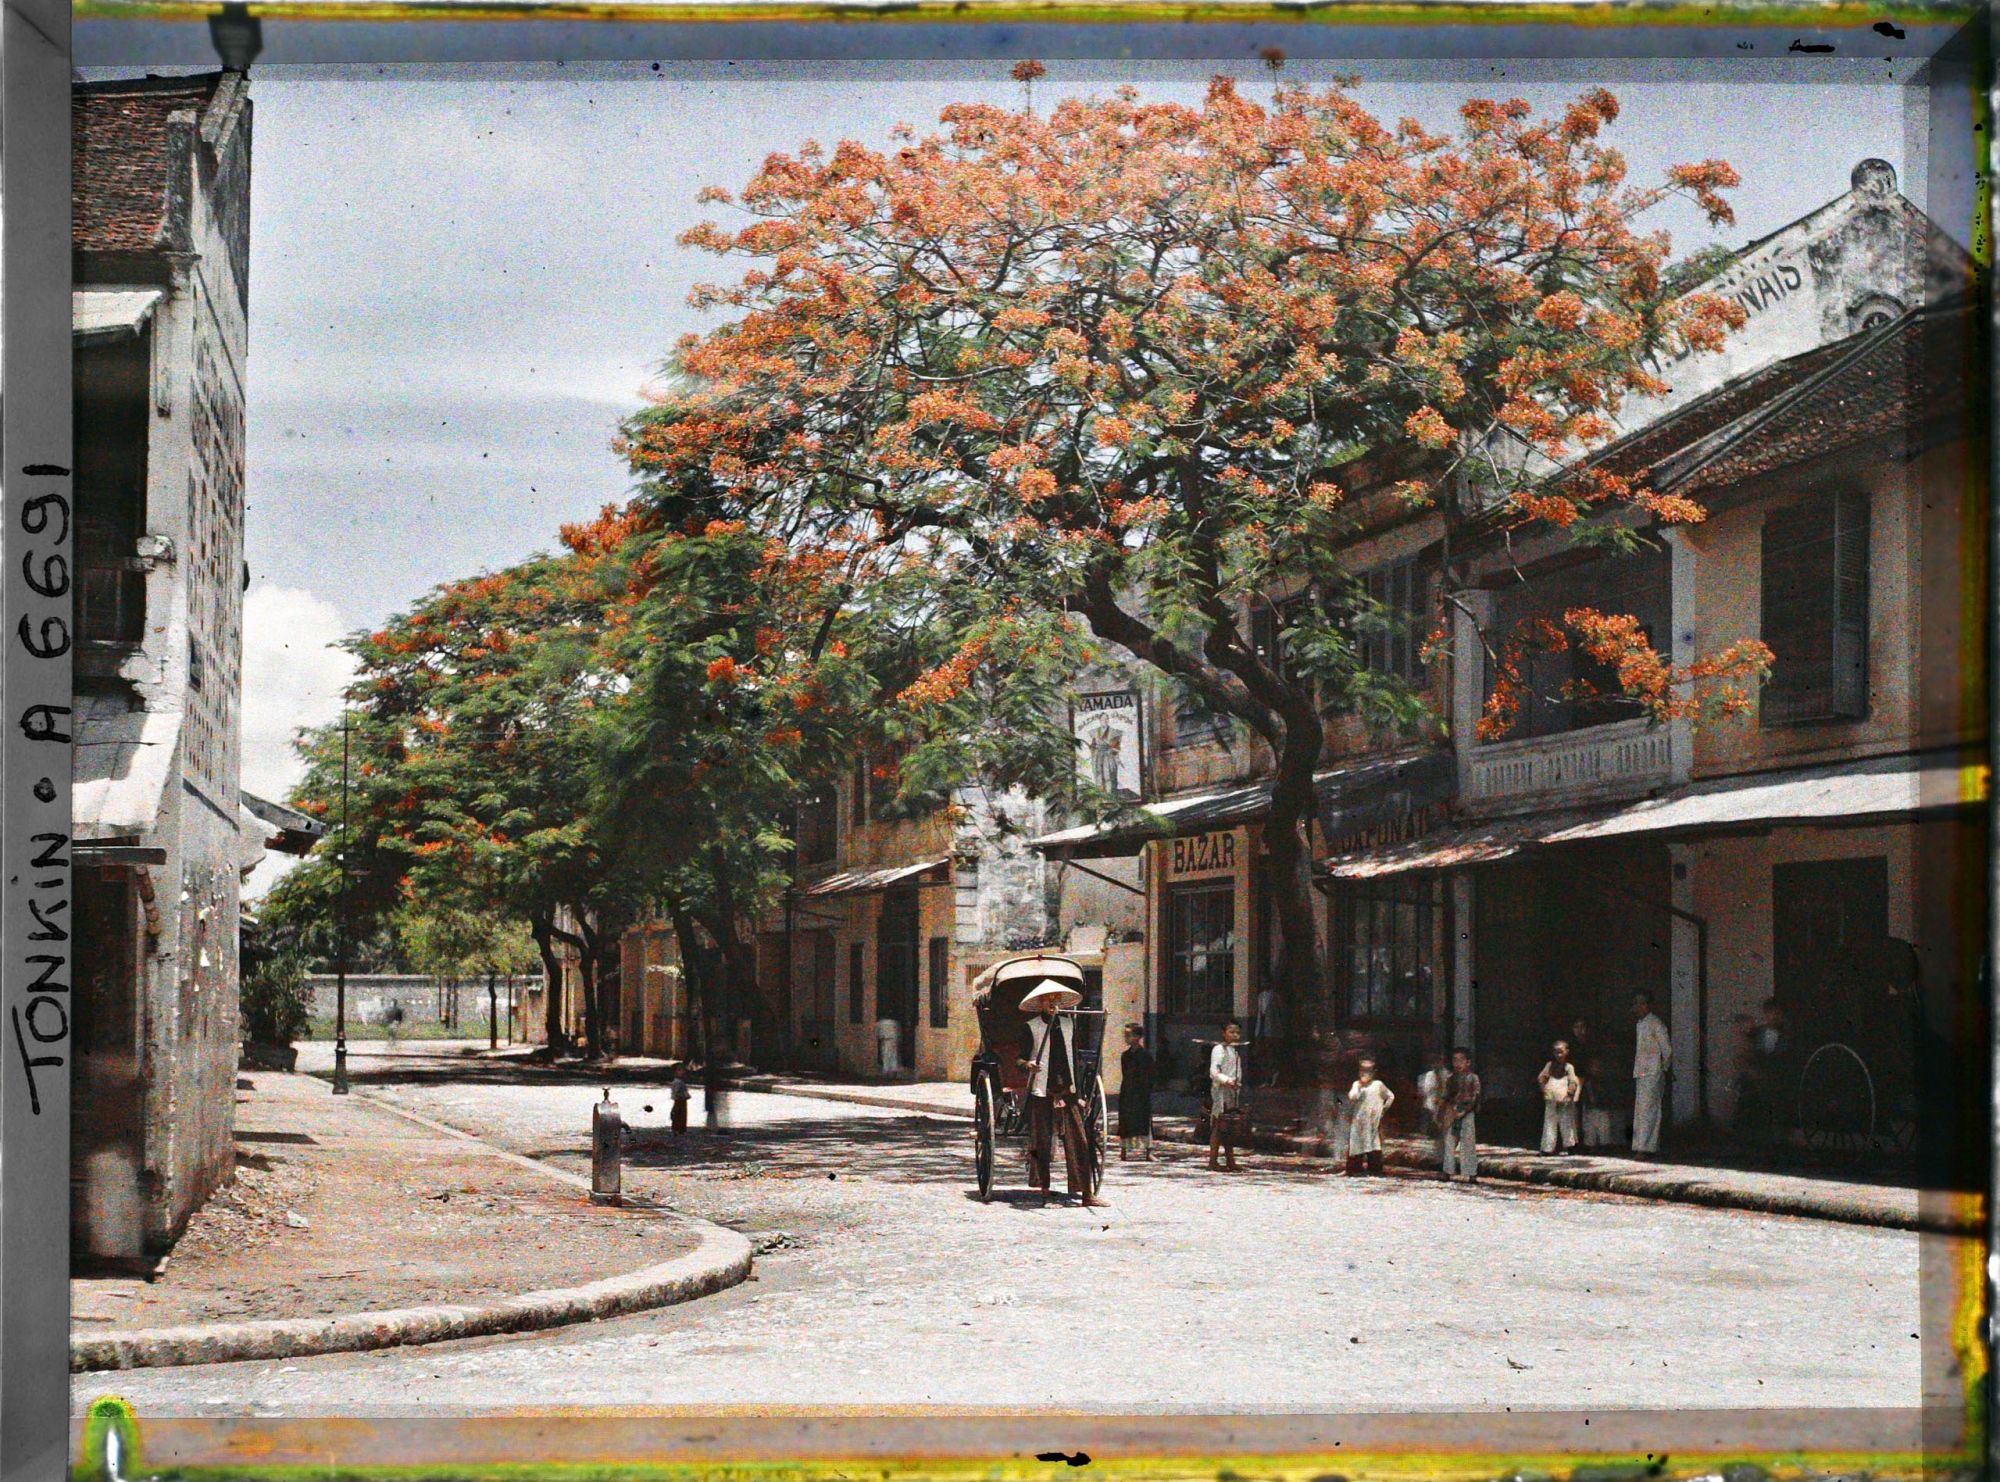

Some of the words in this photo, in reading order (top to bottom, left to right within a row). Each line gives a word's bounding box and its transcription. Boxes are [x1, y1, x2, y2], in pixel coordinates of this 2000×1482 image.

[1736, 264, 1802, 318] NAIS
[18, 463, 71, 659] 6691
[20, 704, 72, 744] A
[1173, 832, 1236, 874] BAZAR
